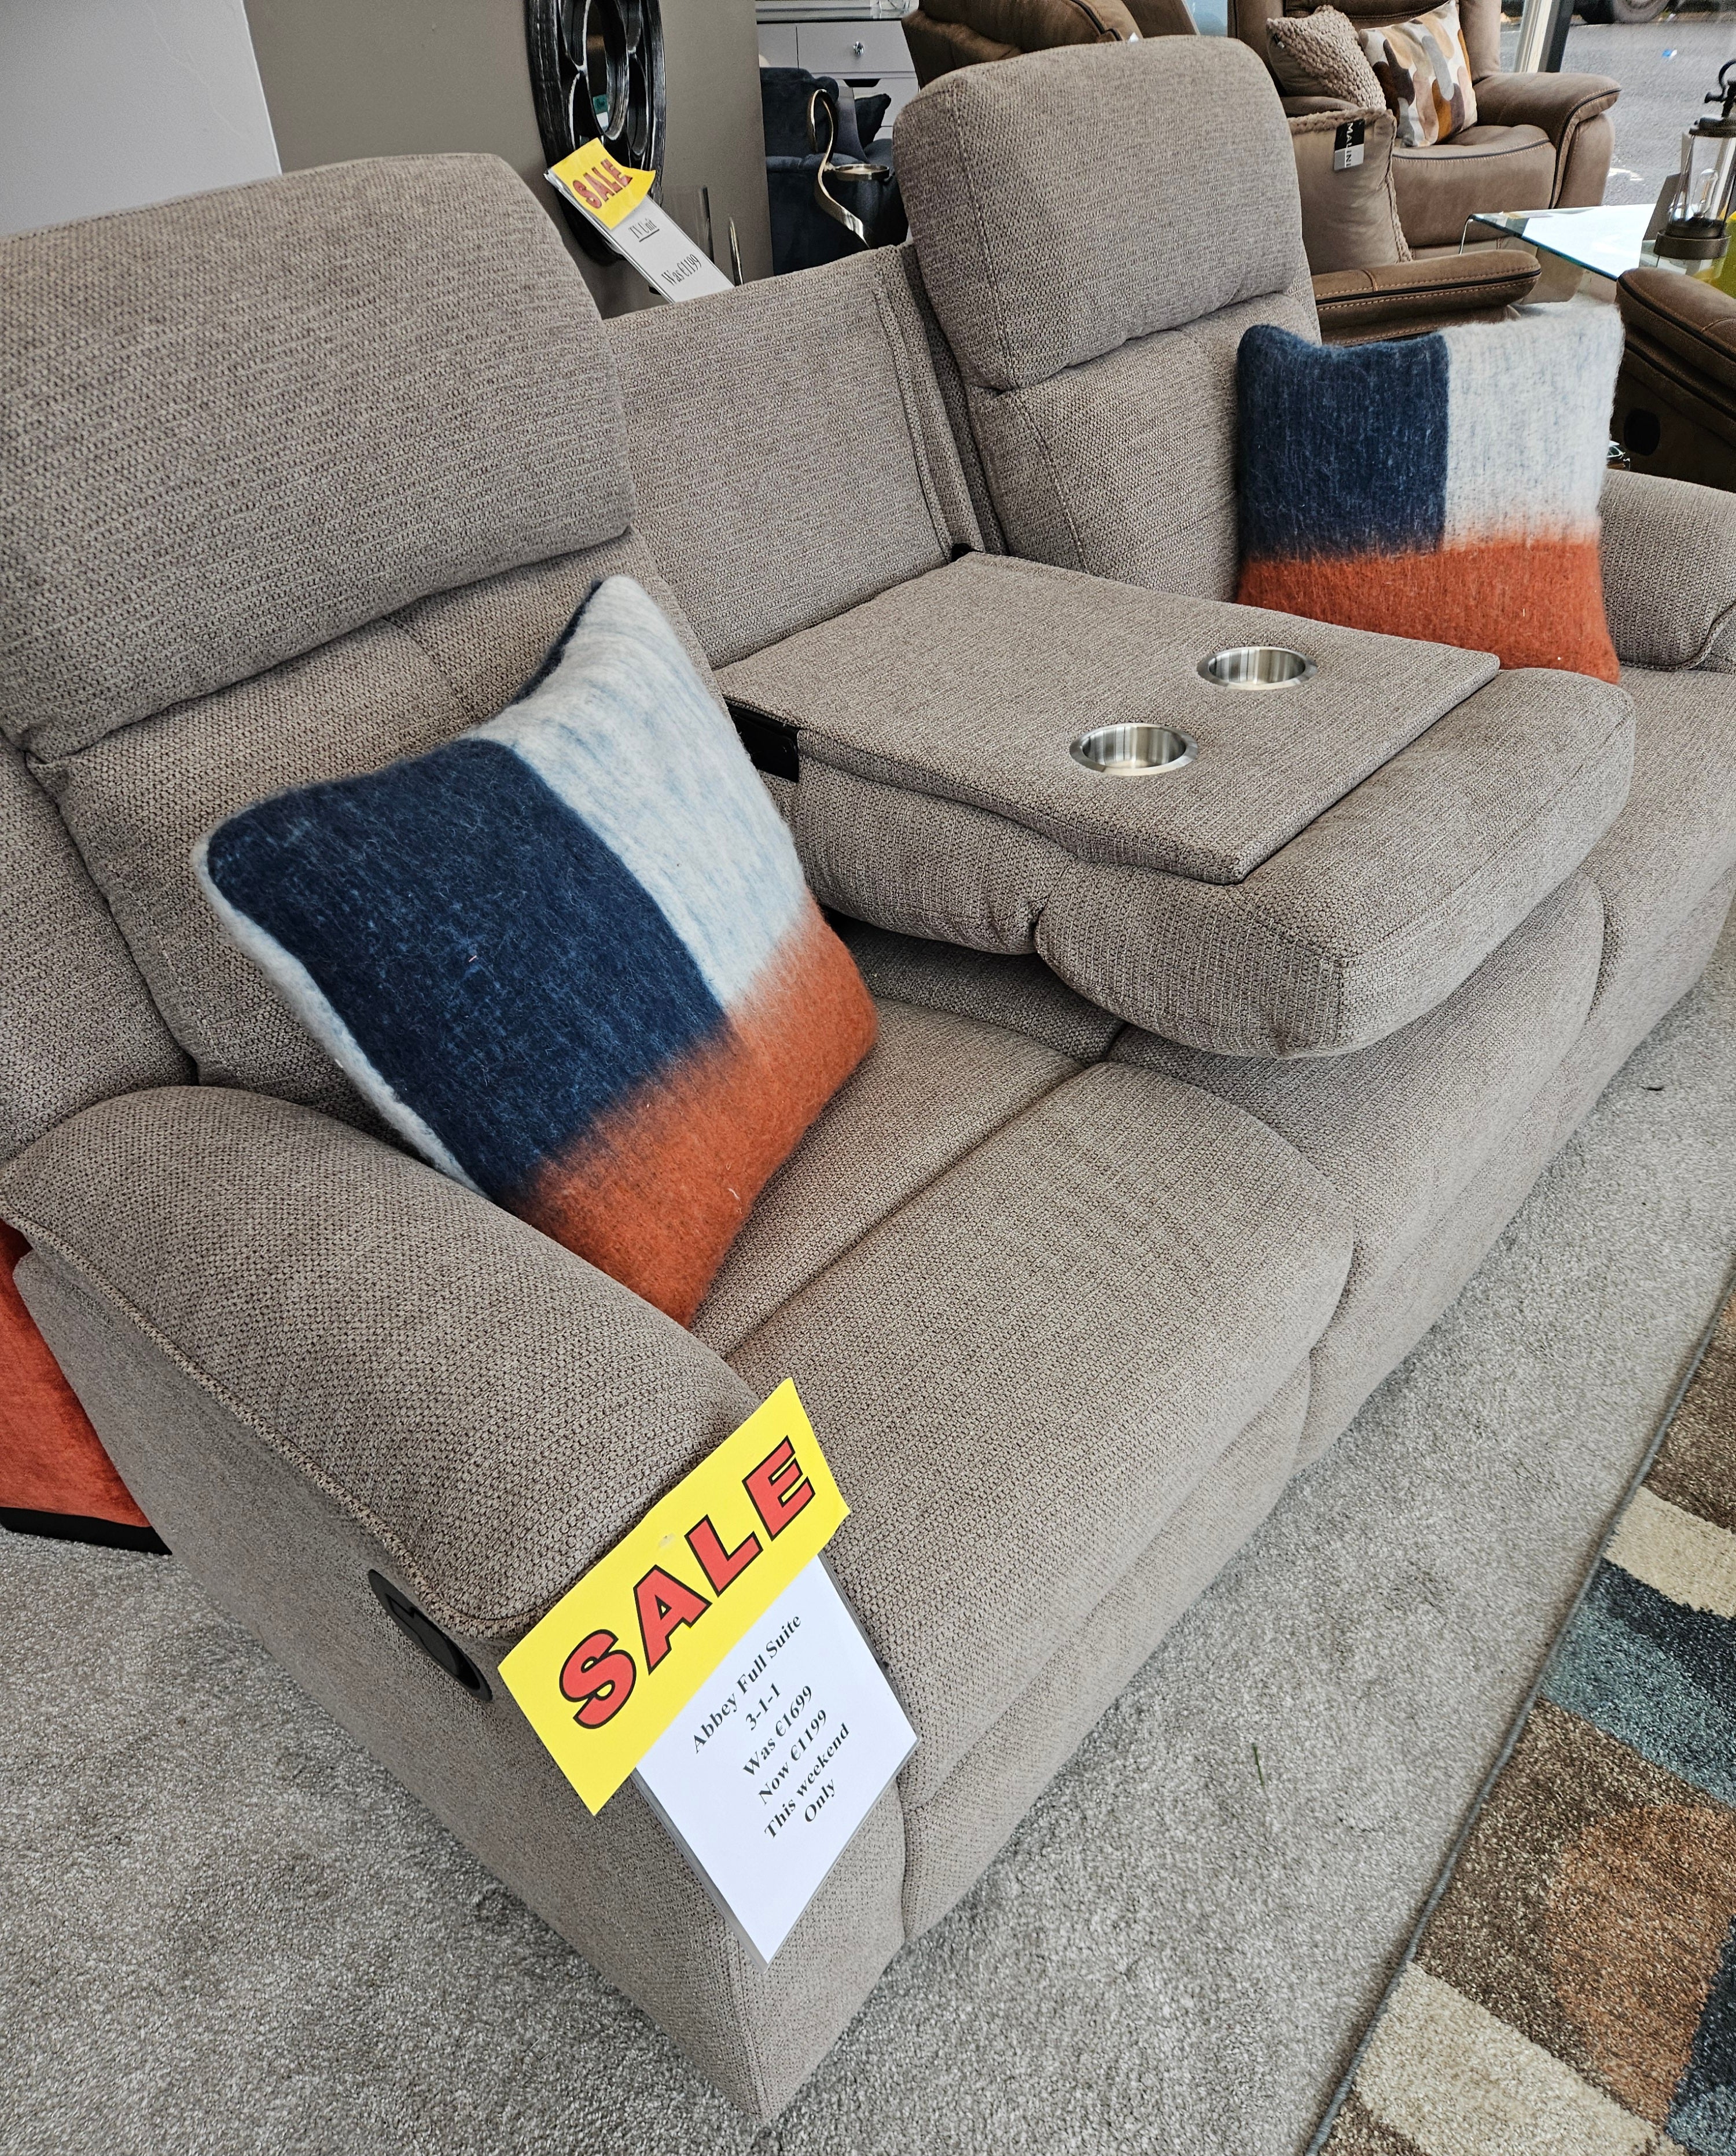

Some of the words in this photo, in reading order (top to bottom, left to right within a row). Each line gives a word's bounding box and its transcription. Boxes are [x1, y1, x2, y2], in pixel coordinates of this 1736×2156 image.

[1345, 122, 1354, 167] MALINI
[572, 158, 633, 209] SALE
[628, 223, 643, 239] TV
[638, 218, 657, 233] Unit
[661, 270, 685, 286] Was
[676, 253, 702, 277] €1199
[559, 1434, 816, 1729] SALE
[694, 1693, 738, 1754] Abbey
[736, 1654, 767, 1695] Full
[766, 1616, 801, 1659] Suite
[745, 1683, 781, 1731] 3-1-1
[742, 1738, 776, 1776] Was
[775, 1685, 812, 1736] €1699
[758, 1762, 789, 1805] Now
[790, 1709, 826, 1761] €1199
[764, 1798, 796, 1839] This
[796, 1722, 849, 1797] weekend
[804, 1778, 836, 1822] Only
